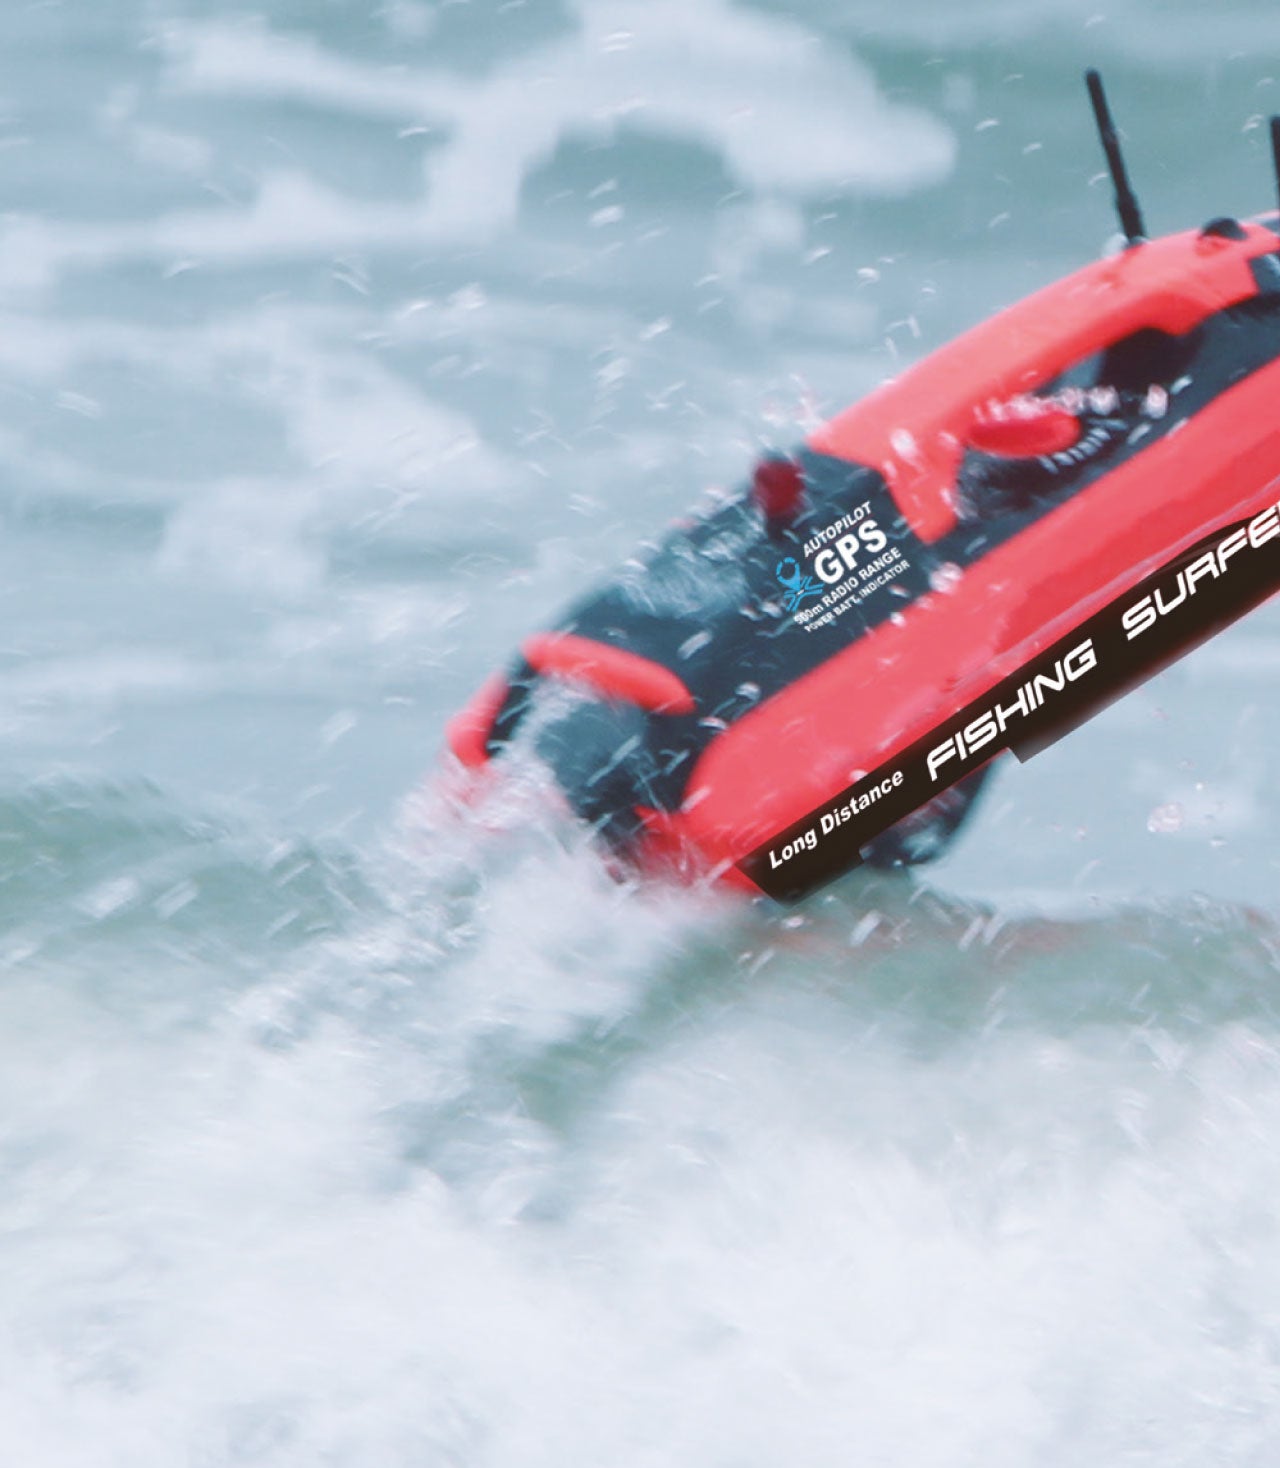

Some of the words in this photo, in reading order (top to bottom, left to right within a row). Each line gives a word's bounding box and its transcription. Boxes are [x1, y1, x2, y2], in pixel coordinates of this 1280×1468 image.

[803, 501, 872, 558] AUTOPILOT
[814, 519, 887, 584] GPS
[804, 613, 835, 633] POWER
[859, 559, 910, 599] INDICATOR
[822, 575, 859, 607] RADIO
[858, 546, 902, 581] RANGE
[926, 638, 1098, 782] FISHING
[768, 826, 818, 870] Long
[819, 768, 905, 835] Distance
